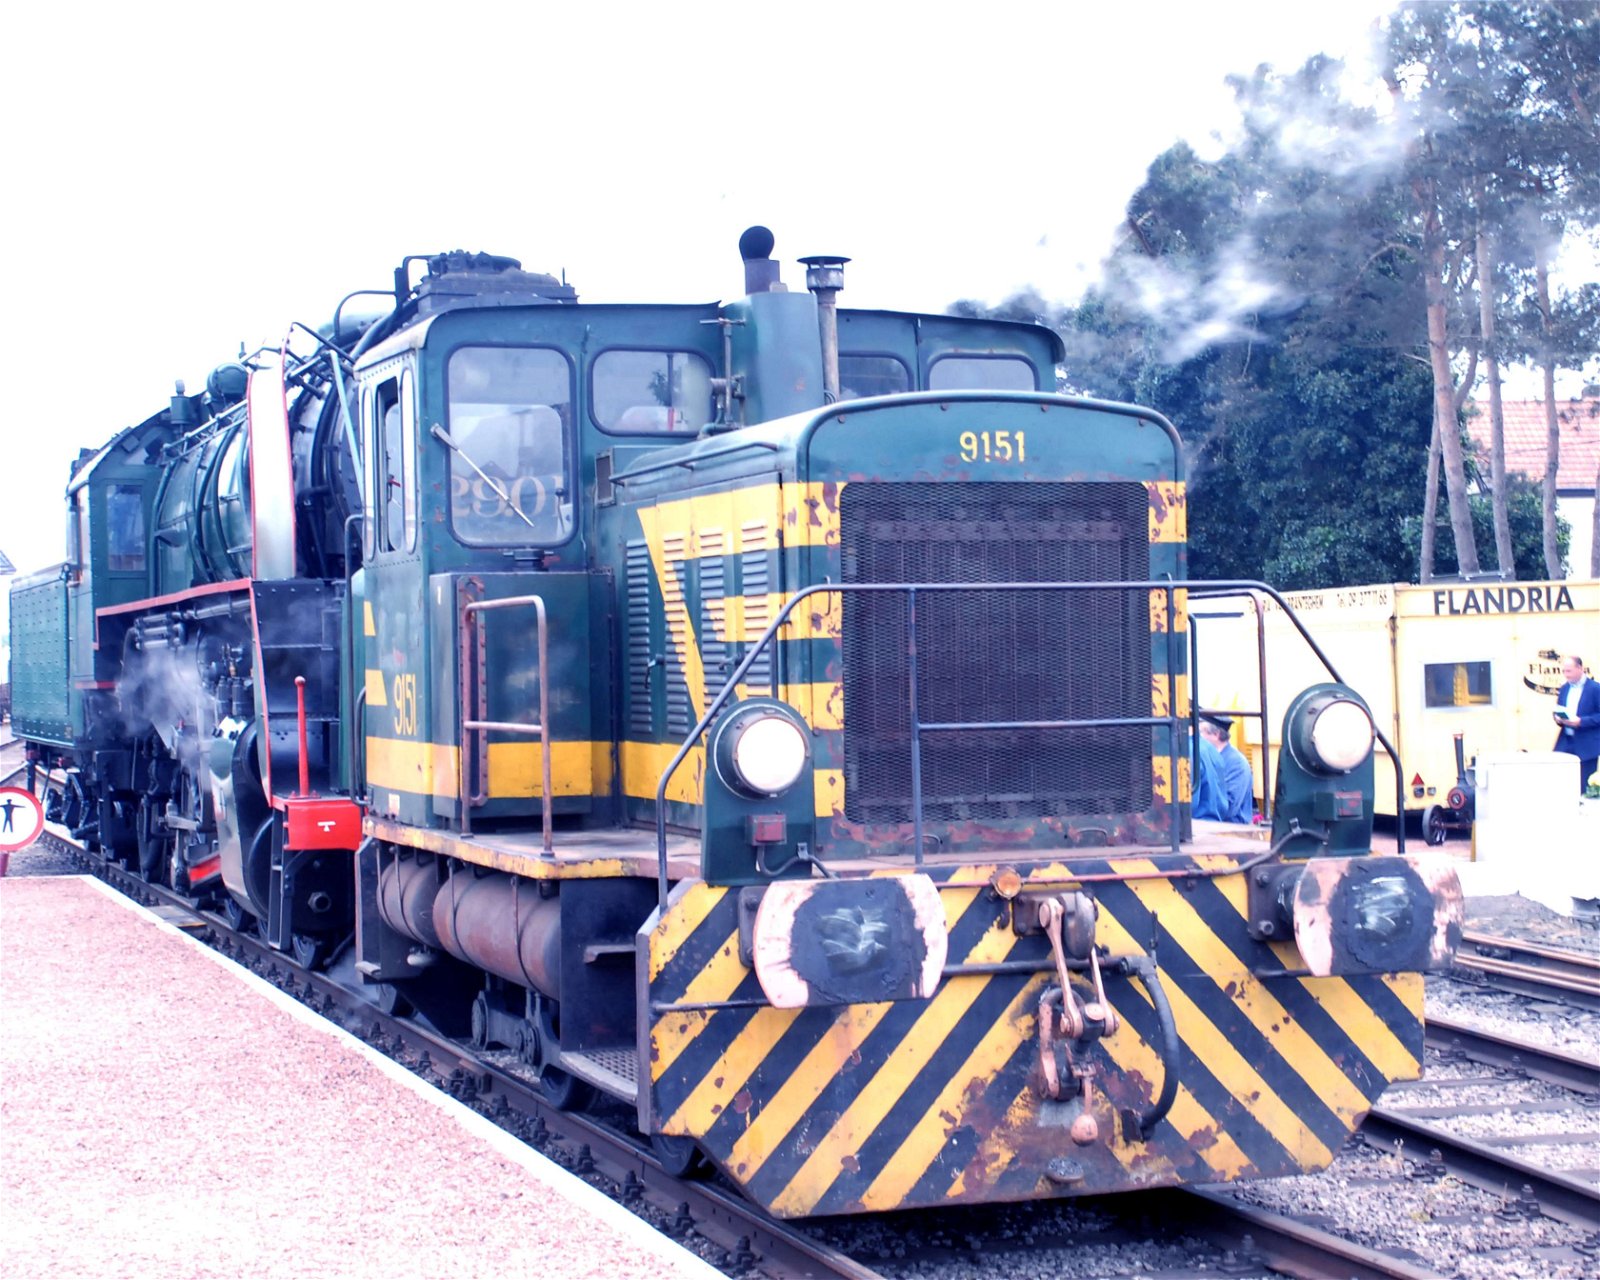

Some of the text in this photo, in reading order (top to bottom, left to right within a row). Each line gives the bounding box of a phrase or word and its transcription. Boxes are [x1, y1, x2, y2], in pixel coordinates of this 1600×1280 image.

[959, 430, 1025, 463] 9151
[1433, 585, 1575, 616] FLANDRIA
[394, 673, 417, 736] 9151
